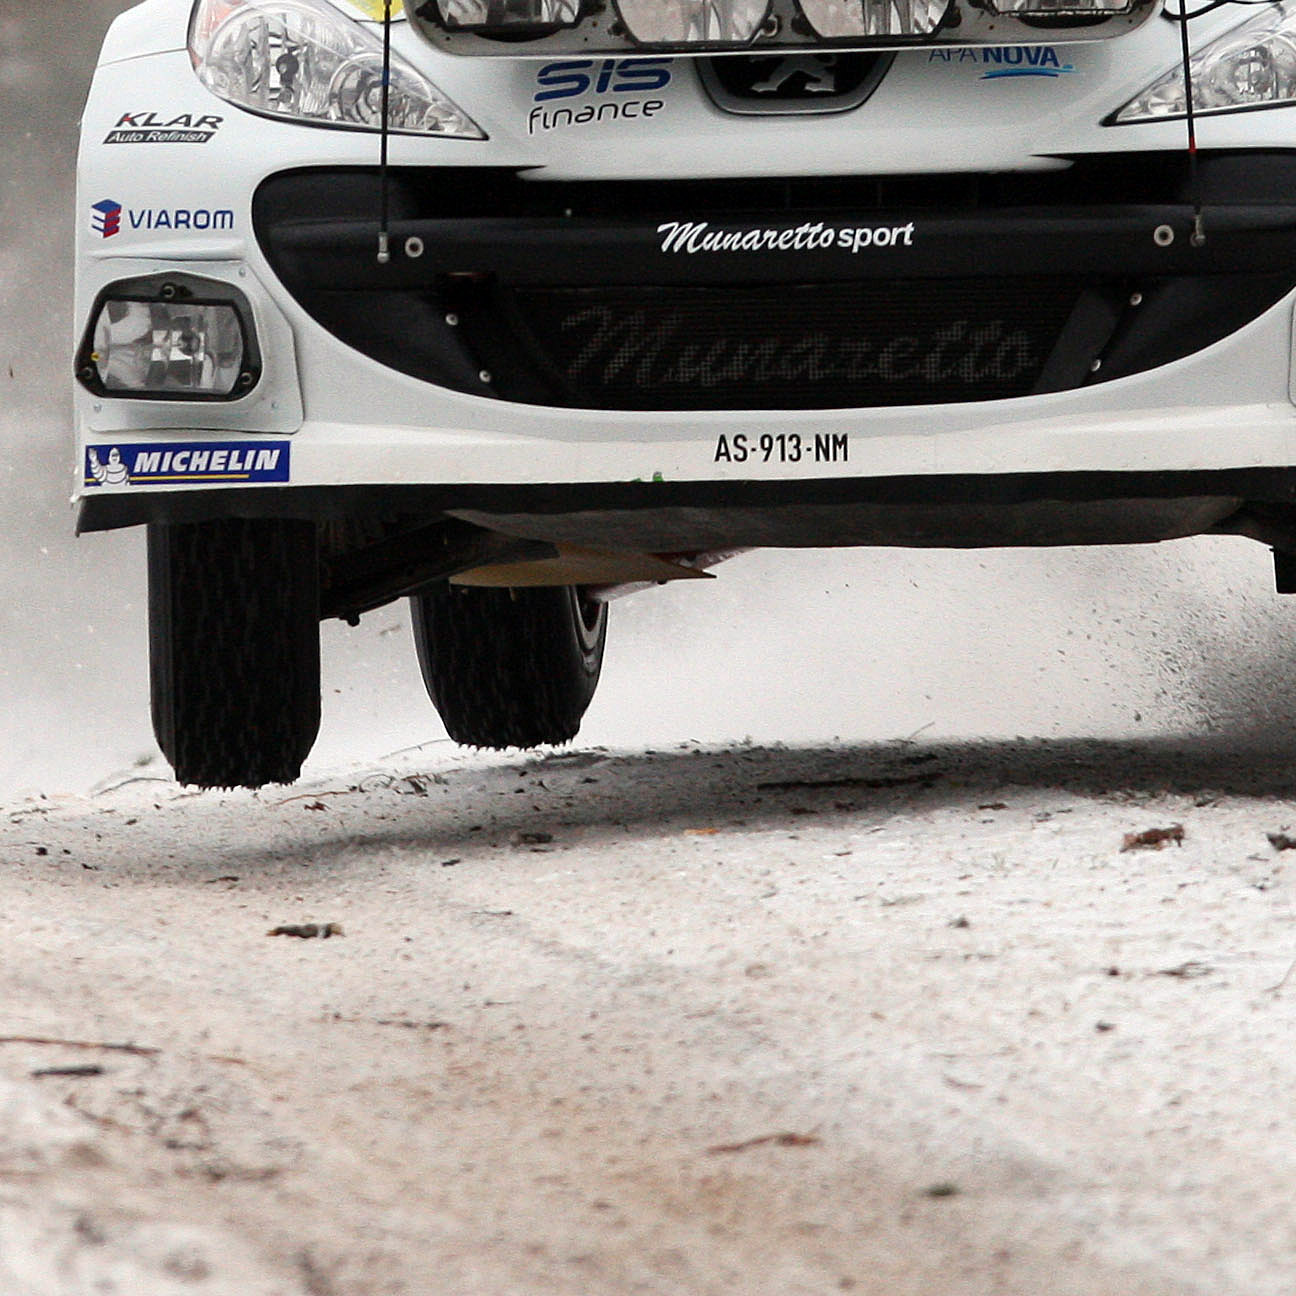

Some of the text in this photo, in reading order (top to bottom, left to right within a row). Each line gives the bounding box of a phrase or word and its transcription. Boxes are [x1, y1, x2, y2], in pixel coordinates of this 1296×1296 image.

[929, 46, 1060, 67] APA NOVA
[535, 58, 671, 102] SIS
[115, 112, 224, 130] KLAR
[528, 99, 665, 135] finance
[108, 130, 207, 143] Auto Refinish
[128, 209, 234, 230] VIAROM
[657, 221, 914, 254] Munaretto sport
[562, 304, 1035, 389] Munaretto
[133, 448, 281, 473] MICHELIN
